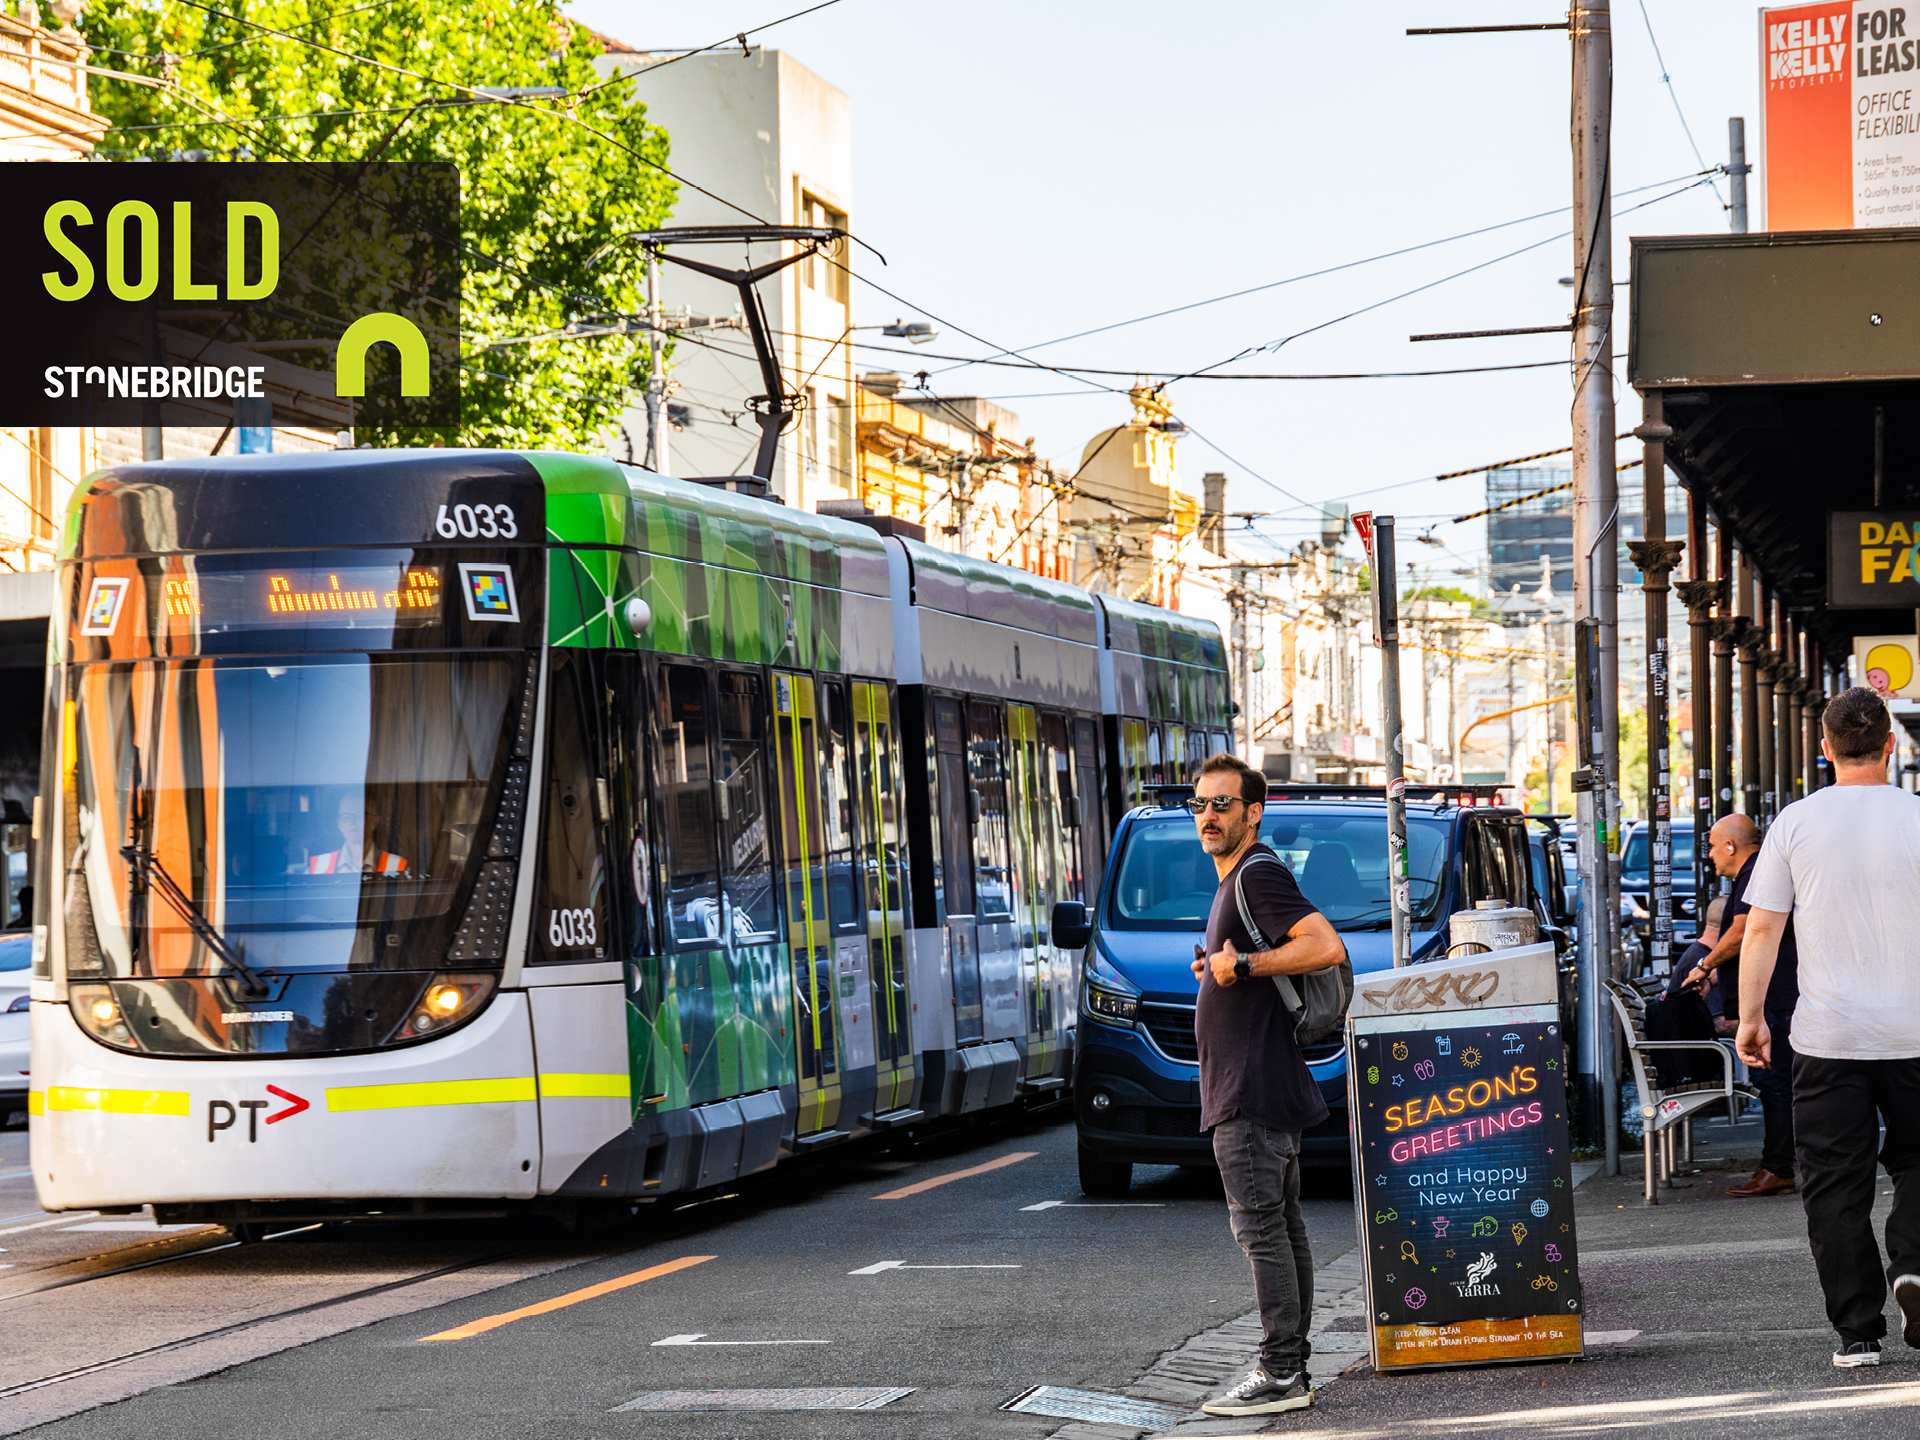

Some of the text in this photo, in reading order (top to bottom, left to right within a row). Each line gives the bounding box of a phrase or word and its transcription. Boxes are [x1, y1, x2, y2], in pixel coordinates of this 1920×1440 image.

[1770, 14, 1847, 52] KELLY
[1857, 7, 1907, 43] FOR
[1770, 72, 1844, 92] PROPERTY
[1857, 89, 1912, 116] OFFICE
[1857, 113, 1920, 140] FLEXIBILI
[1863, 154, 1904, 167] Areas from
[1891, 168, 1899, 177] to
[1864, 186, 1890, 199] Quality
[1901, 184, 1914, 194] out
[1865, 205, 1886, 216] Great
[1887, 200, 1913, 212] natural
[435, 503, 519, 539] 6033
[549, 907, 597, 947] 6033
[1385, 1065, 1538, 1132] SEASON'S
[1391, 1102, 1543, 1163] GREETINGS
[1408, 1166, 1528, 1187] and Happy
[1419, 1186, 1521, 1206] New Year
